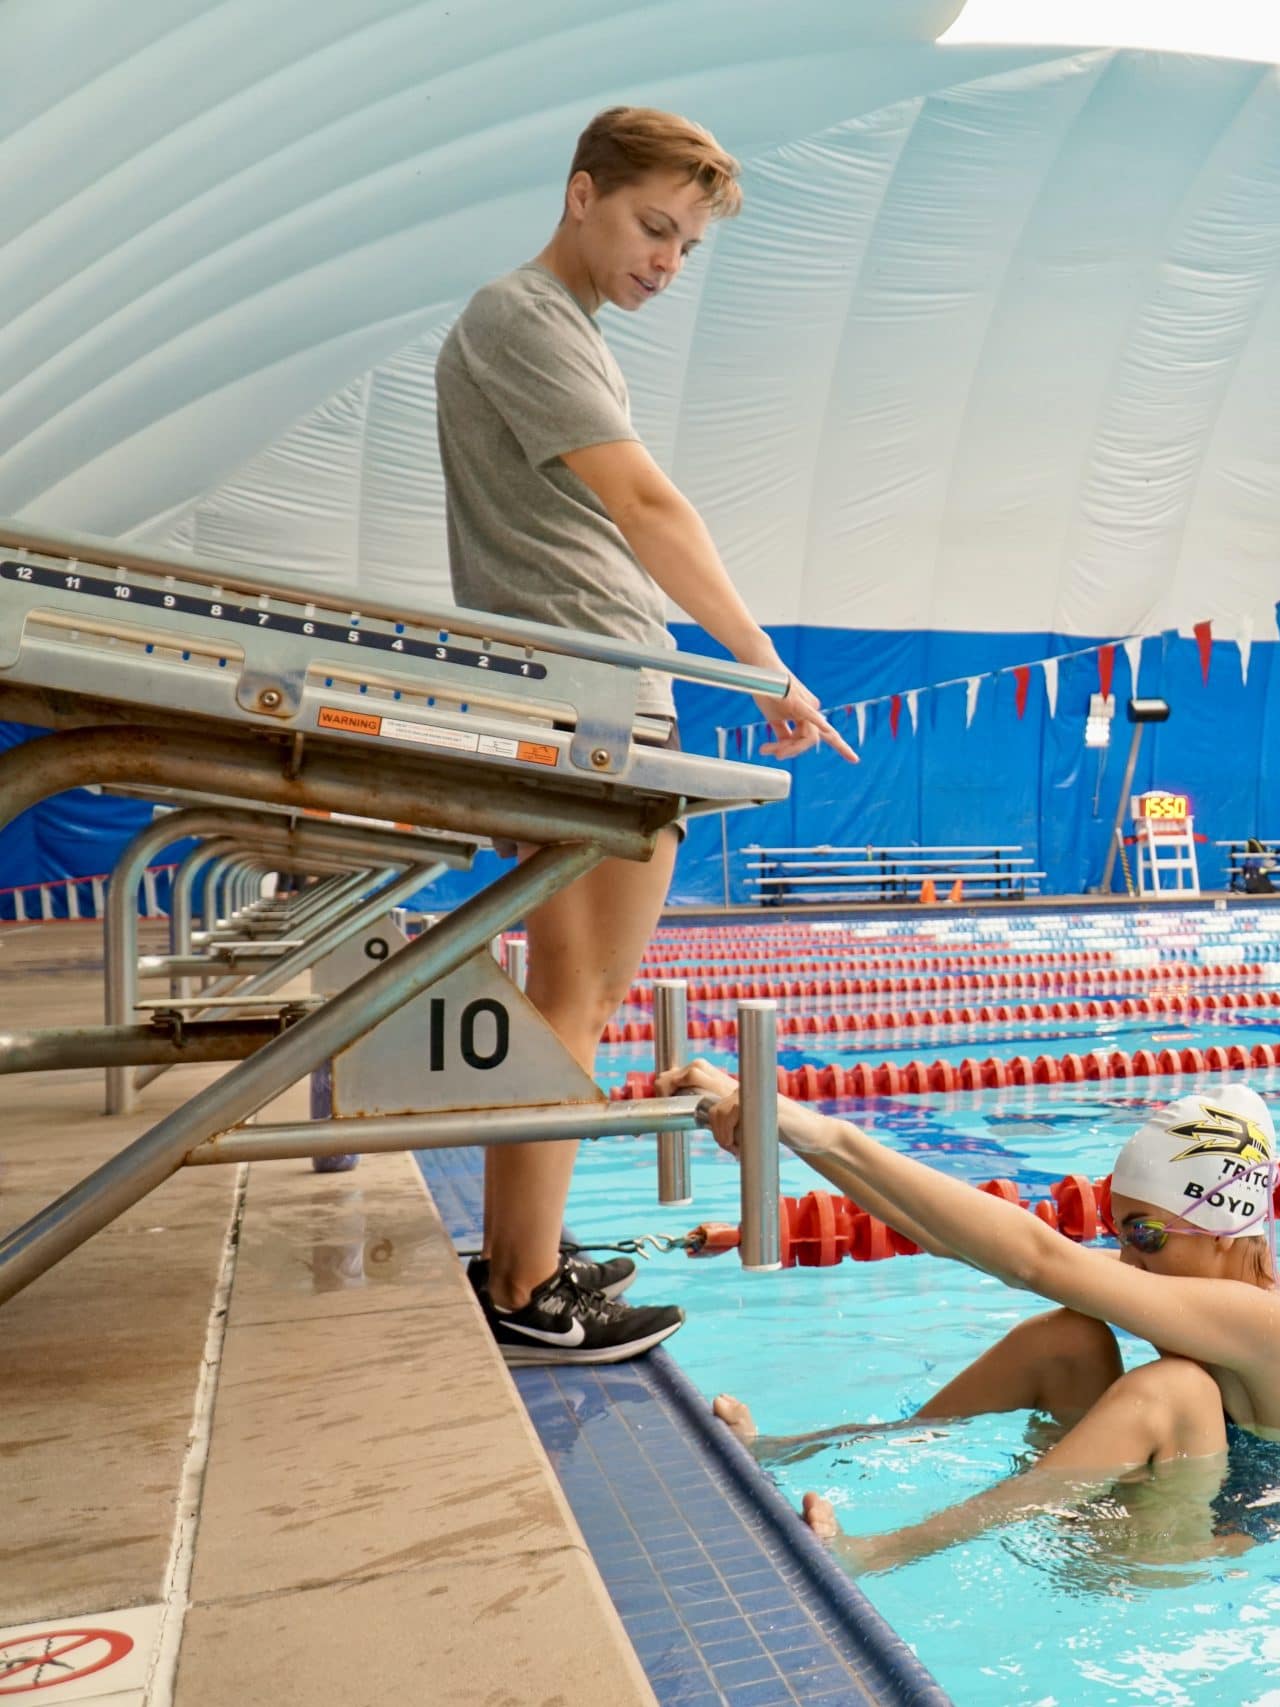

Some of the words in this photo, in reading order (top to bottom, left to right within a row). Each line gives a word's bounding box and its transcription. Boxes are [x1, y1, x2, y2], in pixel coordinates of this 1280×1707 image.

[16, 567, 33, 581] 12
[65, 576, 81, 590] 11
[114, 585, 131, 599] 10
[163, 595, 176, 607] 9
[210, 604, 223, 617] 8
[257, 613, 270, 625] 7
[303, 622, 315, 635] 6
[348, 631, 360, 643] 5
[391, 639, 404, 651] 4
[436, 647, 447, 659] 3
[478, 655, 490, 668] 2
[520, 663, 530, 675] 1
[322, 712, 377, 730] WARNING
[429, 997, 510, 1072] 10
[1184, 1182, 1255, 1217] BOYD
